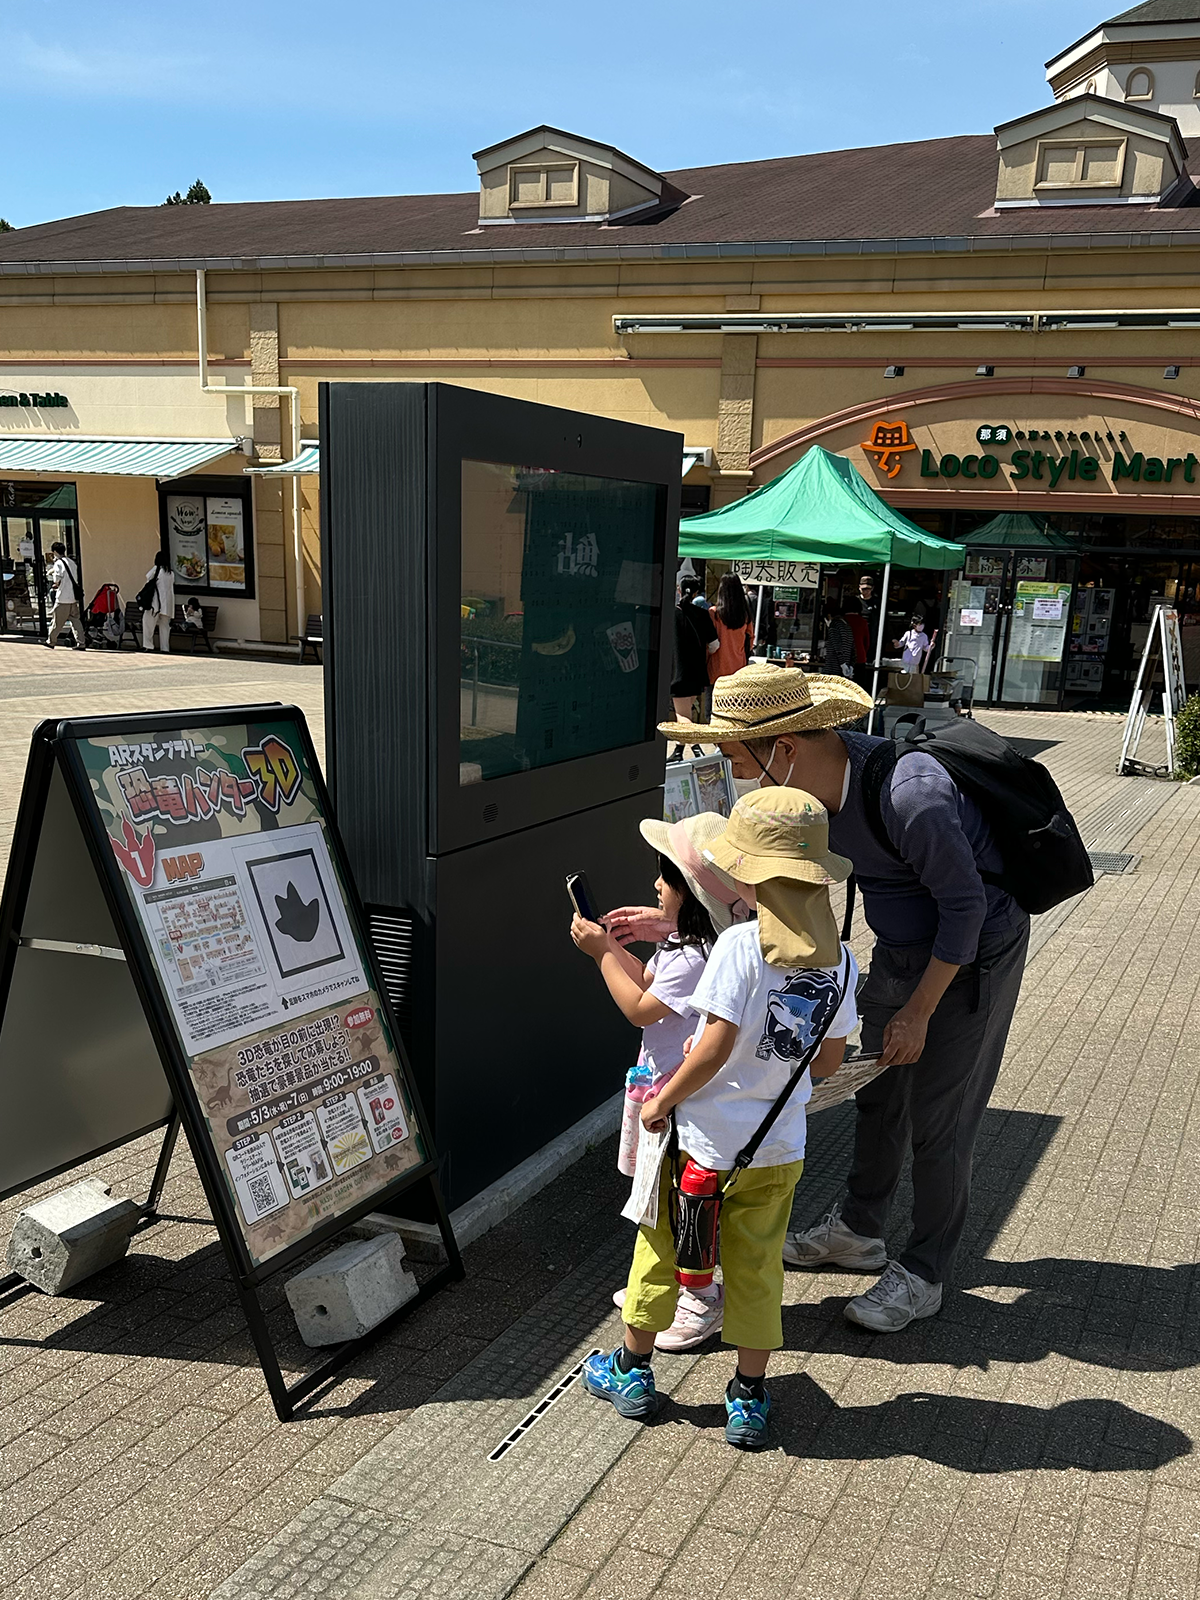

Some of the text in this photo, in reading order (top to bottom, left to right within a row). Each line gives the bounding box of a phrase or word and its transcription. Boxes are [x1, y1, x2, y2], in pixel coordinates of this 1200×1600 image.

[19, 392, 31, 407] &
[29, 392, 68, 407] Table
[920, 449, 1196, 487] Loco Style Mart
[733, 560, 820, 585] 陶器販売
[108, 740, 205, 768] ARスタンプラリー
[161, 852, 204, 882] MAP
[346, 1008, 373, 1028] 参加無料
[326, 1095, 339, 1106] STEP
[283, 1115, 296, 1126] STEP
[236, 1136, 251, 1148] STEP
[320, 1193, 333, 1205] NASU
[334, 1182, 353, 1197] GARDEN
